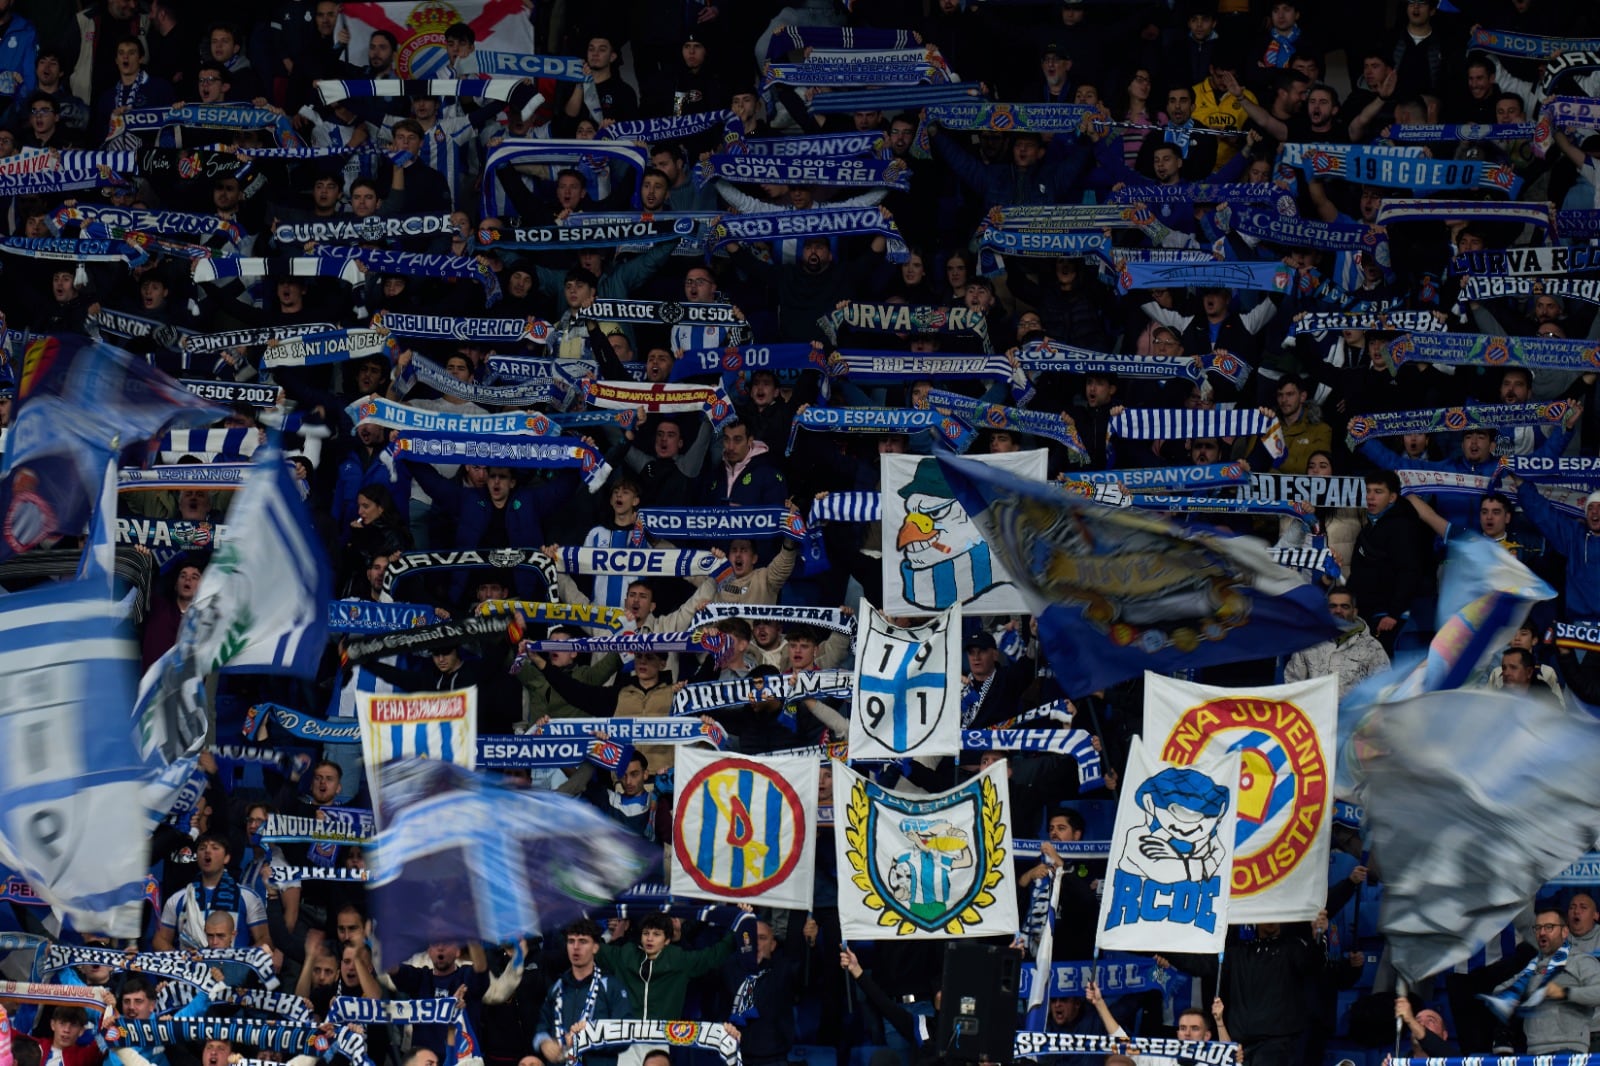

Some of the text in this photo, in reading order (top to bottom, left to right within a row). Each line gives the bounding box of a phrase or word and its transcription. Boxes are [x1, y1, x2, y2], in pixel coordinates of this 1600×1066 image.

[400, 34, 447, 73] CLUB DEPOR
[1504, 36, 1537, 52] RCD
[497, 53, 586, 78] RCDE
[125, 113, 159, 125] RCD
[610, 119, 646, 138] RCD
[773, 137, 873, 157] ESPANYOL
[720, 162, 876, 182] COPA DEL REI
[735, 156, 864, 169] FINAL 2005-06
[276, 220, 361, 243] CURVA
[515, 221, 659, 243] RCD ESPANYOL
[726, 211, 887, 238] RCD ESPANYOL
[1253, 212, 1362, 243] Centenari
[984, 228, 1018, 250] RCD
[369, 250, 480, 275] ESPANYOL
[384, 313, 521, 336] ORGULLO PERICO
[290, 335, 358, 359] SANT JOAN
[1445, 337, 1474, 348] CLUB
[697, 347, 771, 370] 19 00
[1111, 361, 1178, 377] sentiment
[237, 386, 276, 403] 2002
[385, 404, 517, 432] NO SURRENDER
[803, 410, 936, 426] RCD ESPANYOL
[411, 438, 571, 460] RCD ESPANYOL
[1516, 456, 1555, 471] RCD
[1123, 466, 1215, 487] ESPANYOL
[646, 513, 777, 530] RCD ESPANYOL
[592, 550, 666, 573] RCDE
[717, 606, 833, 622] ES NUESTRA
[590, 642, 654, 652] BARCELONA
[881, 643, 895, 674] 1
[673, 680, 749, 713] PIRITU
[866, 692, 928, 730] 9 1
[967, 730, 989, 748] &
[1230, 703, 1322, 796] JUVENIL
[483, 742, 584, 759] ESPANYOL
[1083, 841, 1098, 850] DE
[1104, 868, 1222, 935] RCDE
[126, 1022, 305, 1051] RCD ESPANYOL
